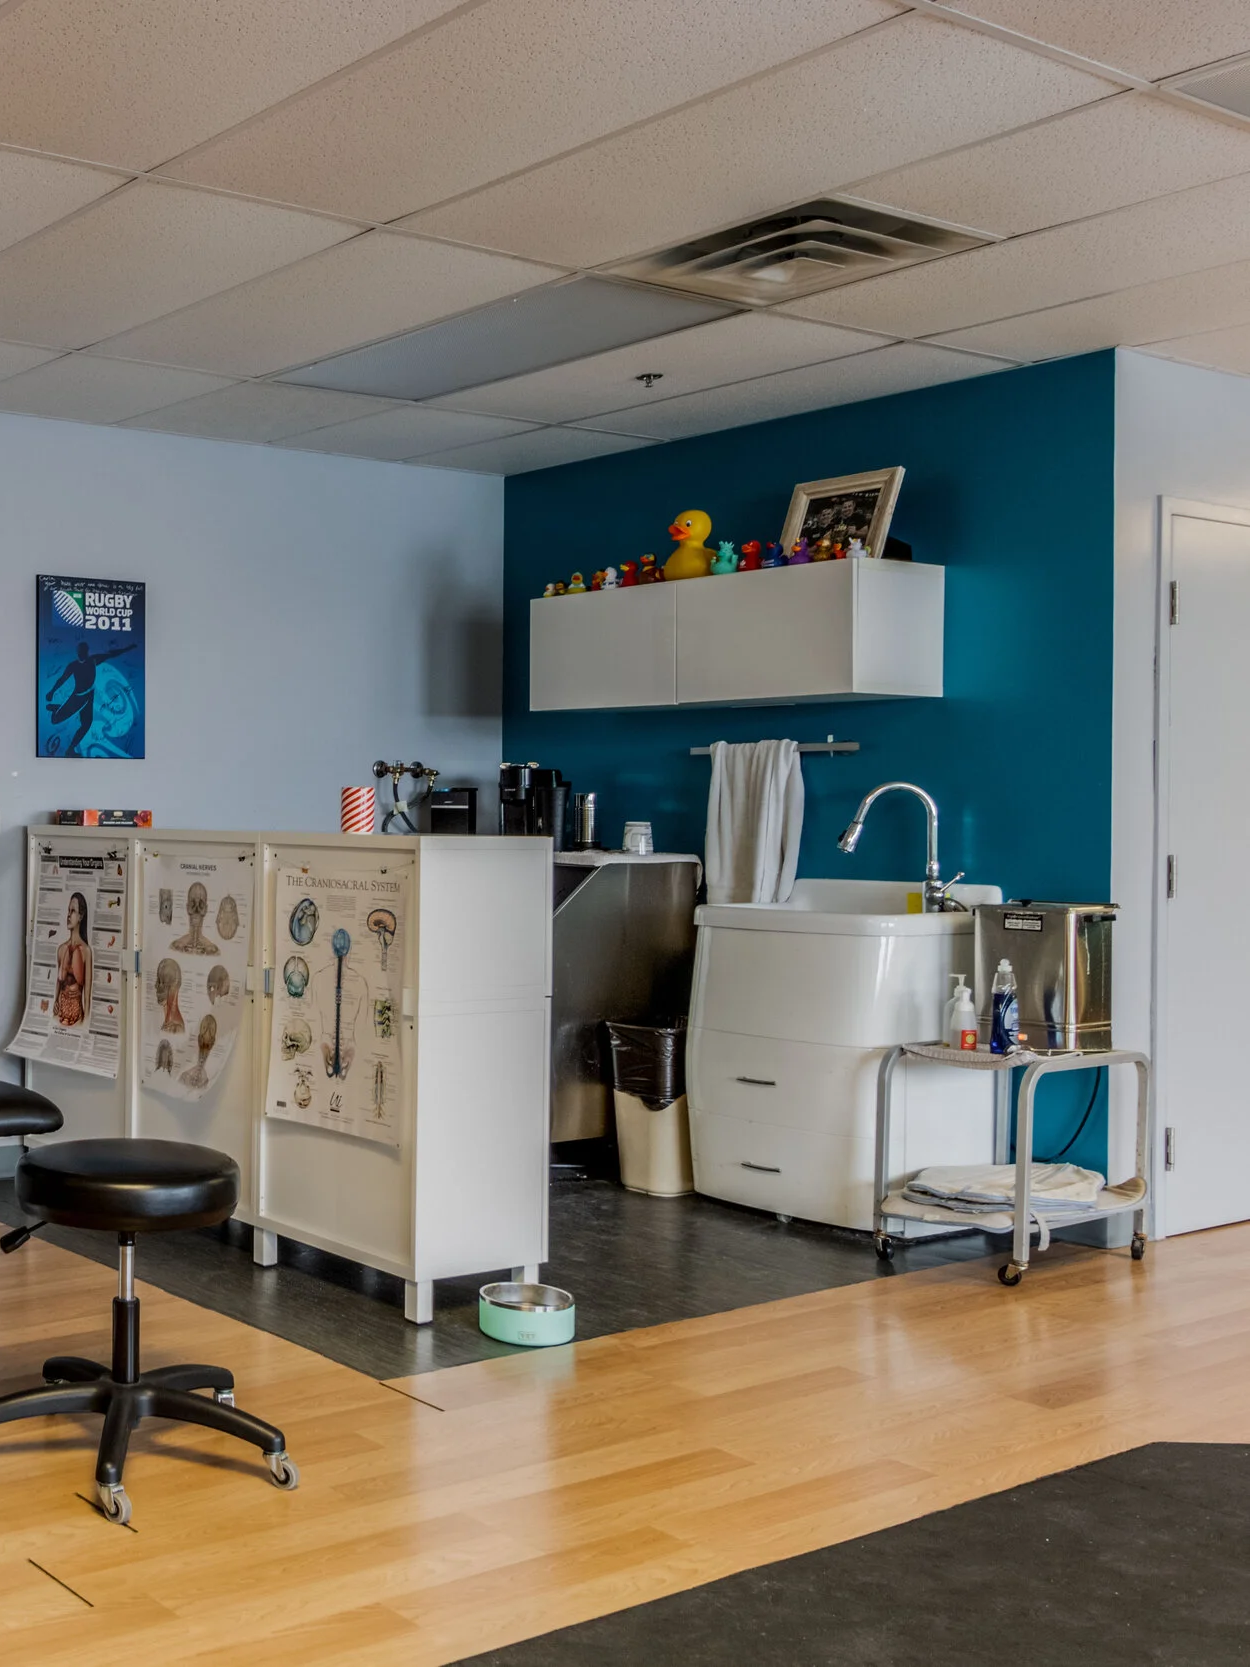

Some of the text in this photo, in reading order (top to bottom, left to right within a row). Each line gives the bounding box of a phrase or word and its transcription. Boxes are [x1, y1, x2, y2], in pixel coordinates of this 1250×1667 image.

[85, 592, 133, 608] RUGBY
[85, 607, 133, 617] WORLD CUP
[84, 616, 132, 631] 2011
[286, 874, 401, 893] THE CRANIOSACRAL SYSTEM
